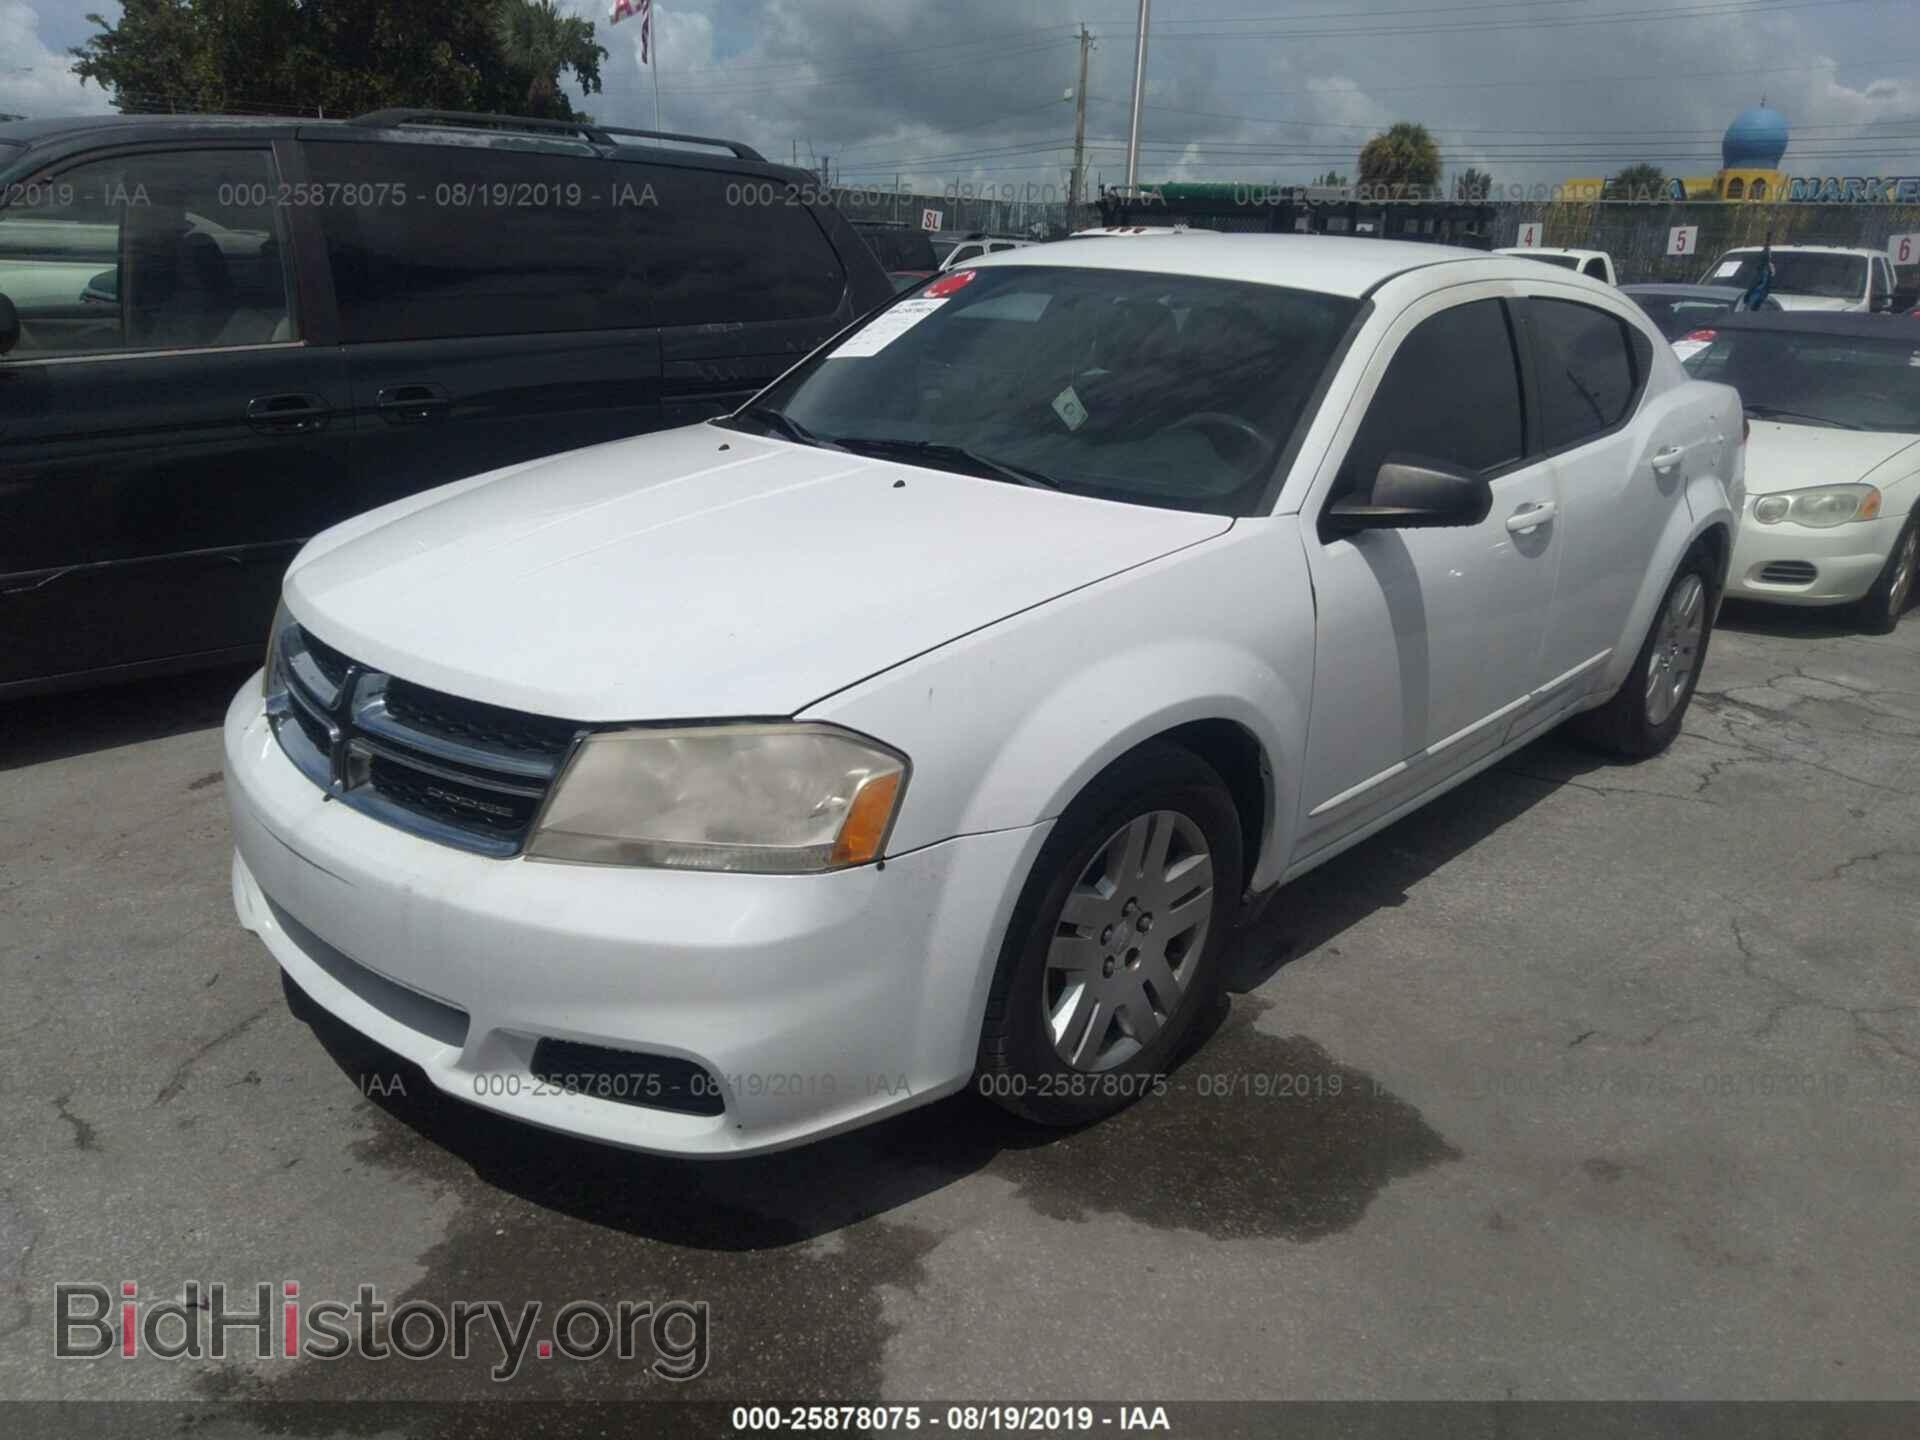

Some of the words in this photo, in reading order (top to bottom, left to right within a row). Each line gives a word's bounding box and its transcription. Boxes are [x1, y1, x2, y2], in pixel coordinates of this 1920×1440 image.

[924, 211, 939, 230] SL
[1524, 227, 1534, 247] 4
[1676, 230, 1687, 252] 5
[1898, 238, 1911, 262] 6
